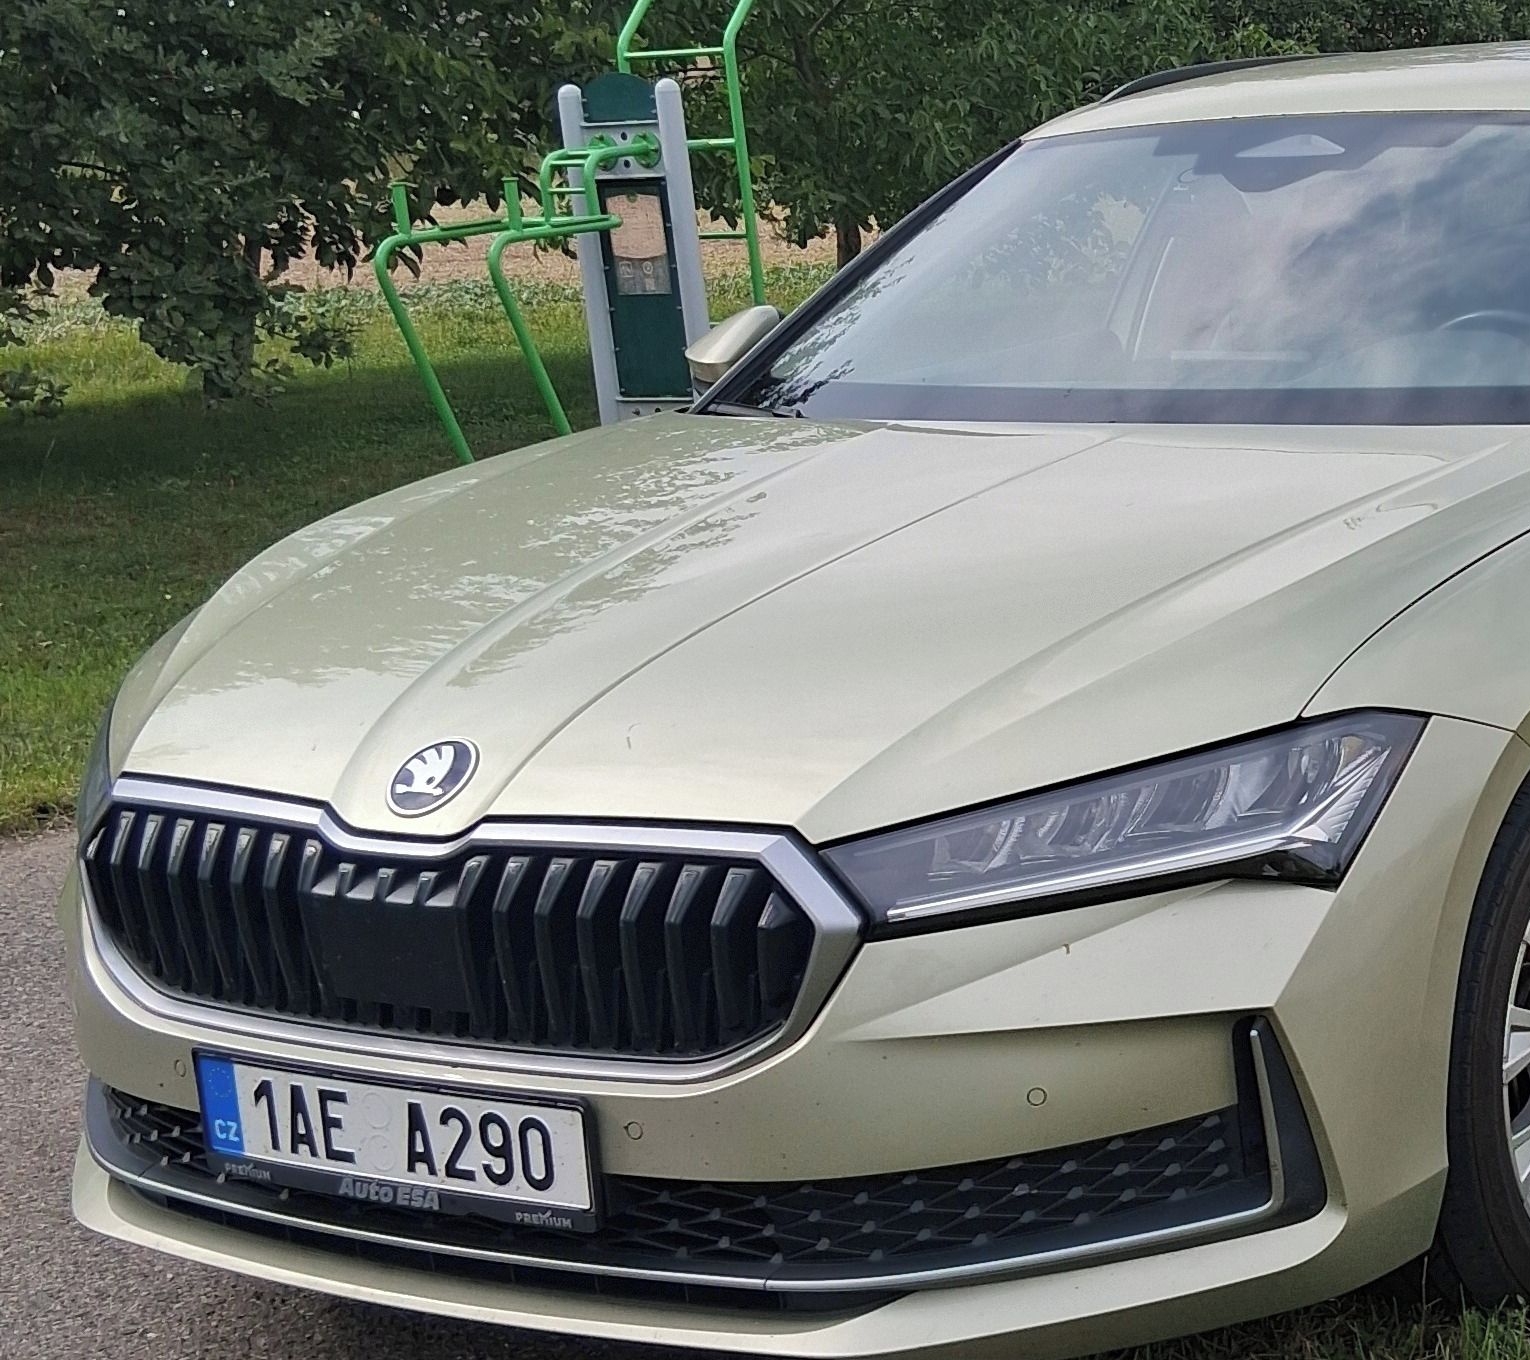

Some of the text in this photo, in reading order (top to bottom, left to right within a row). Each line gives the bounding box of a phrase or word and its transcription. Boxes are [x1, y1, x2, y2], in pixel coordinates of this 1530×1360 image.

[215, 1119, 239, 1141] CZ
[253, 1078, 555, 1192] 1AE A290
[338, 1177, 440, 1211] Auto ESA
[515, 1210, 573, 1229] PREMIUM
